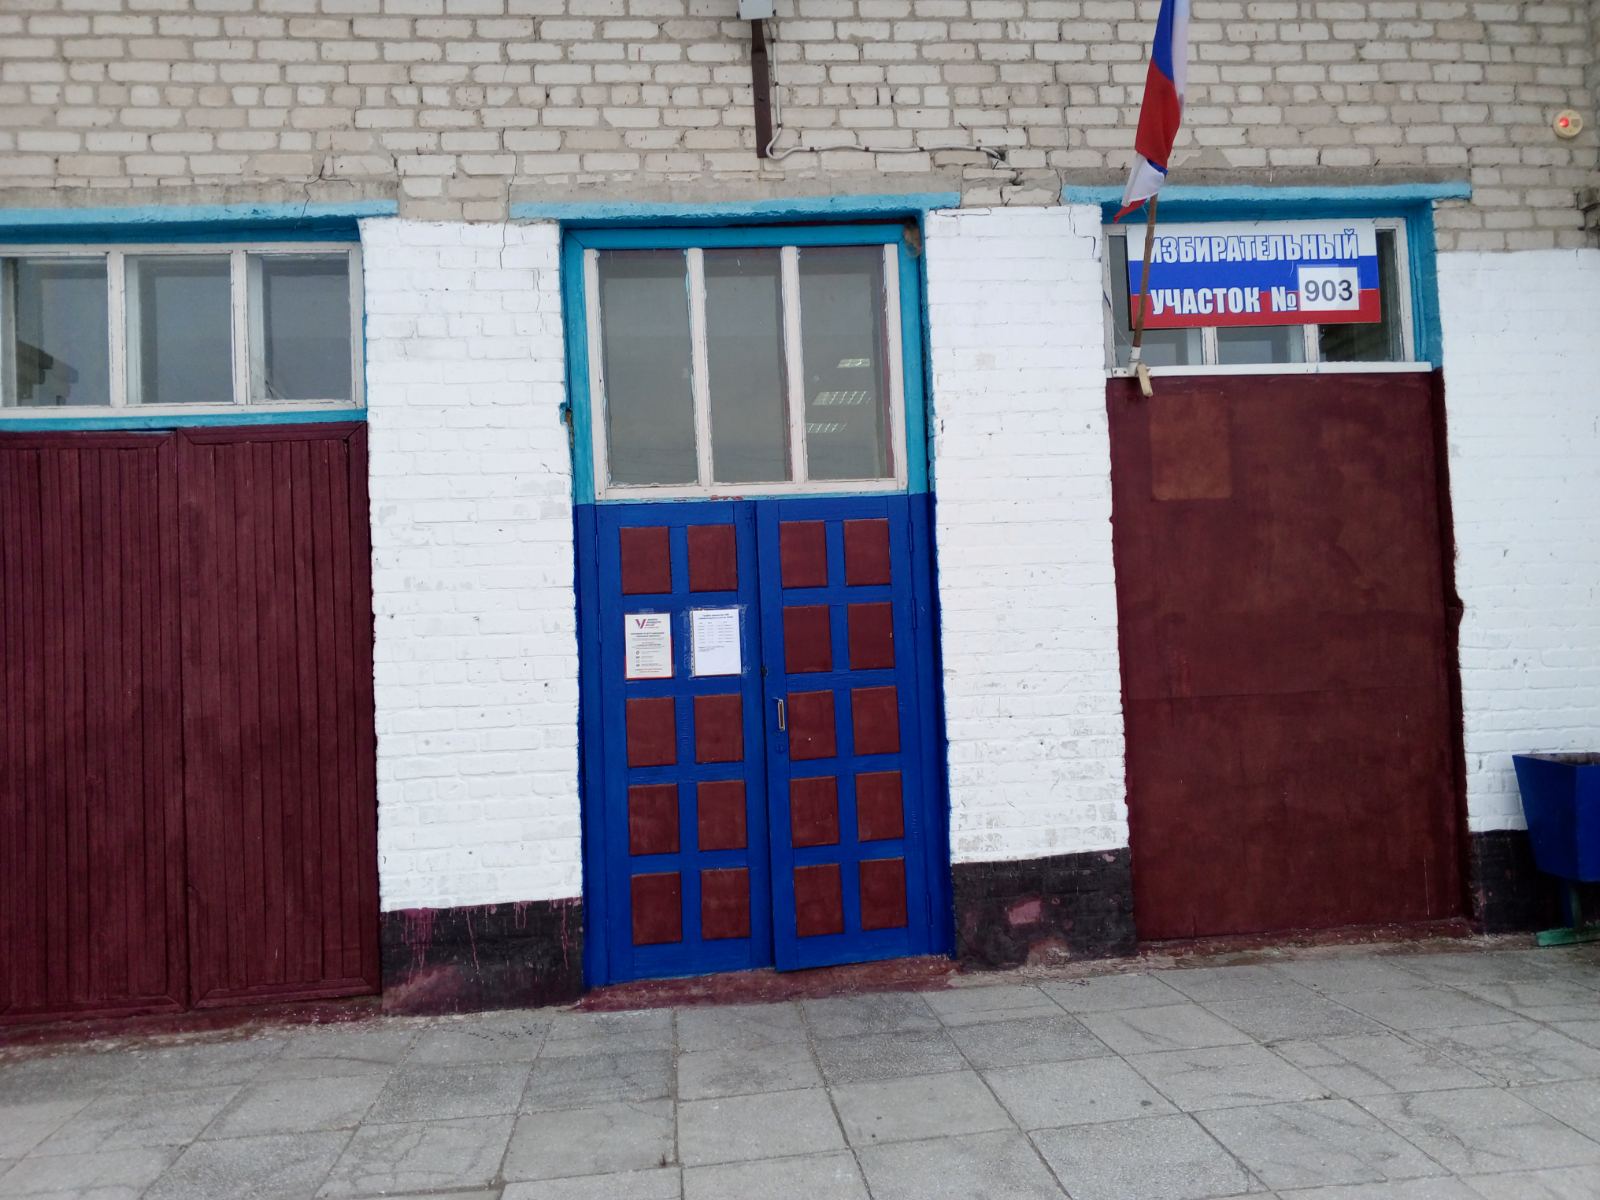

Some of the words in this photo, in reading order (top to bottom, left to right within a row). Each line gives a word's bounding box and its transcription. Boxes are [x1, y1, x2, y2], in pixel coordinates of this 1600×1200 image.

[1150, 286, 1261, 315] УЧАСТОК
[1271, 286, 1298, 312] №
[1304, 279, 1353, 302] 903
